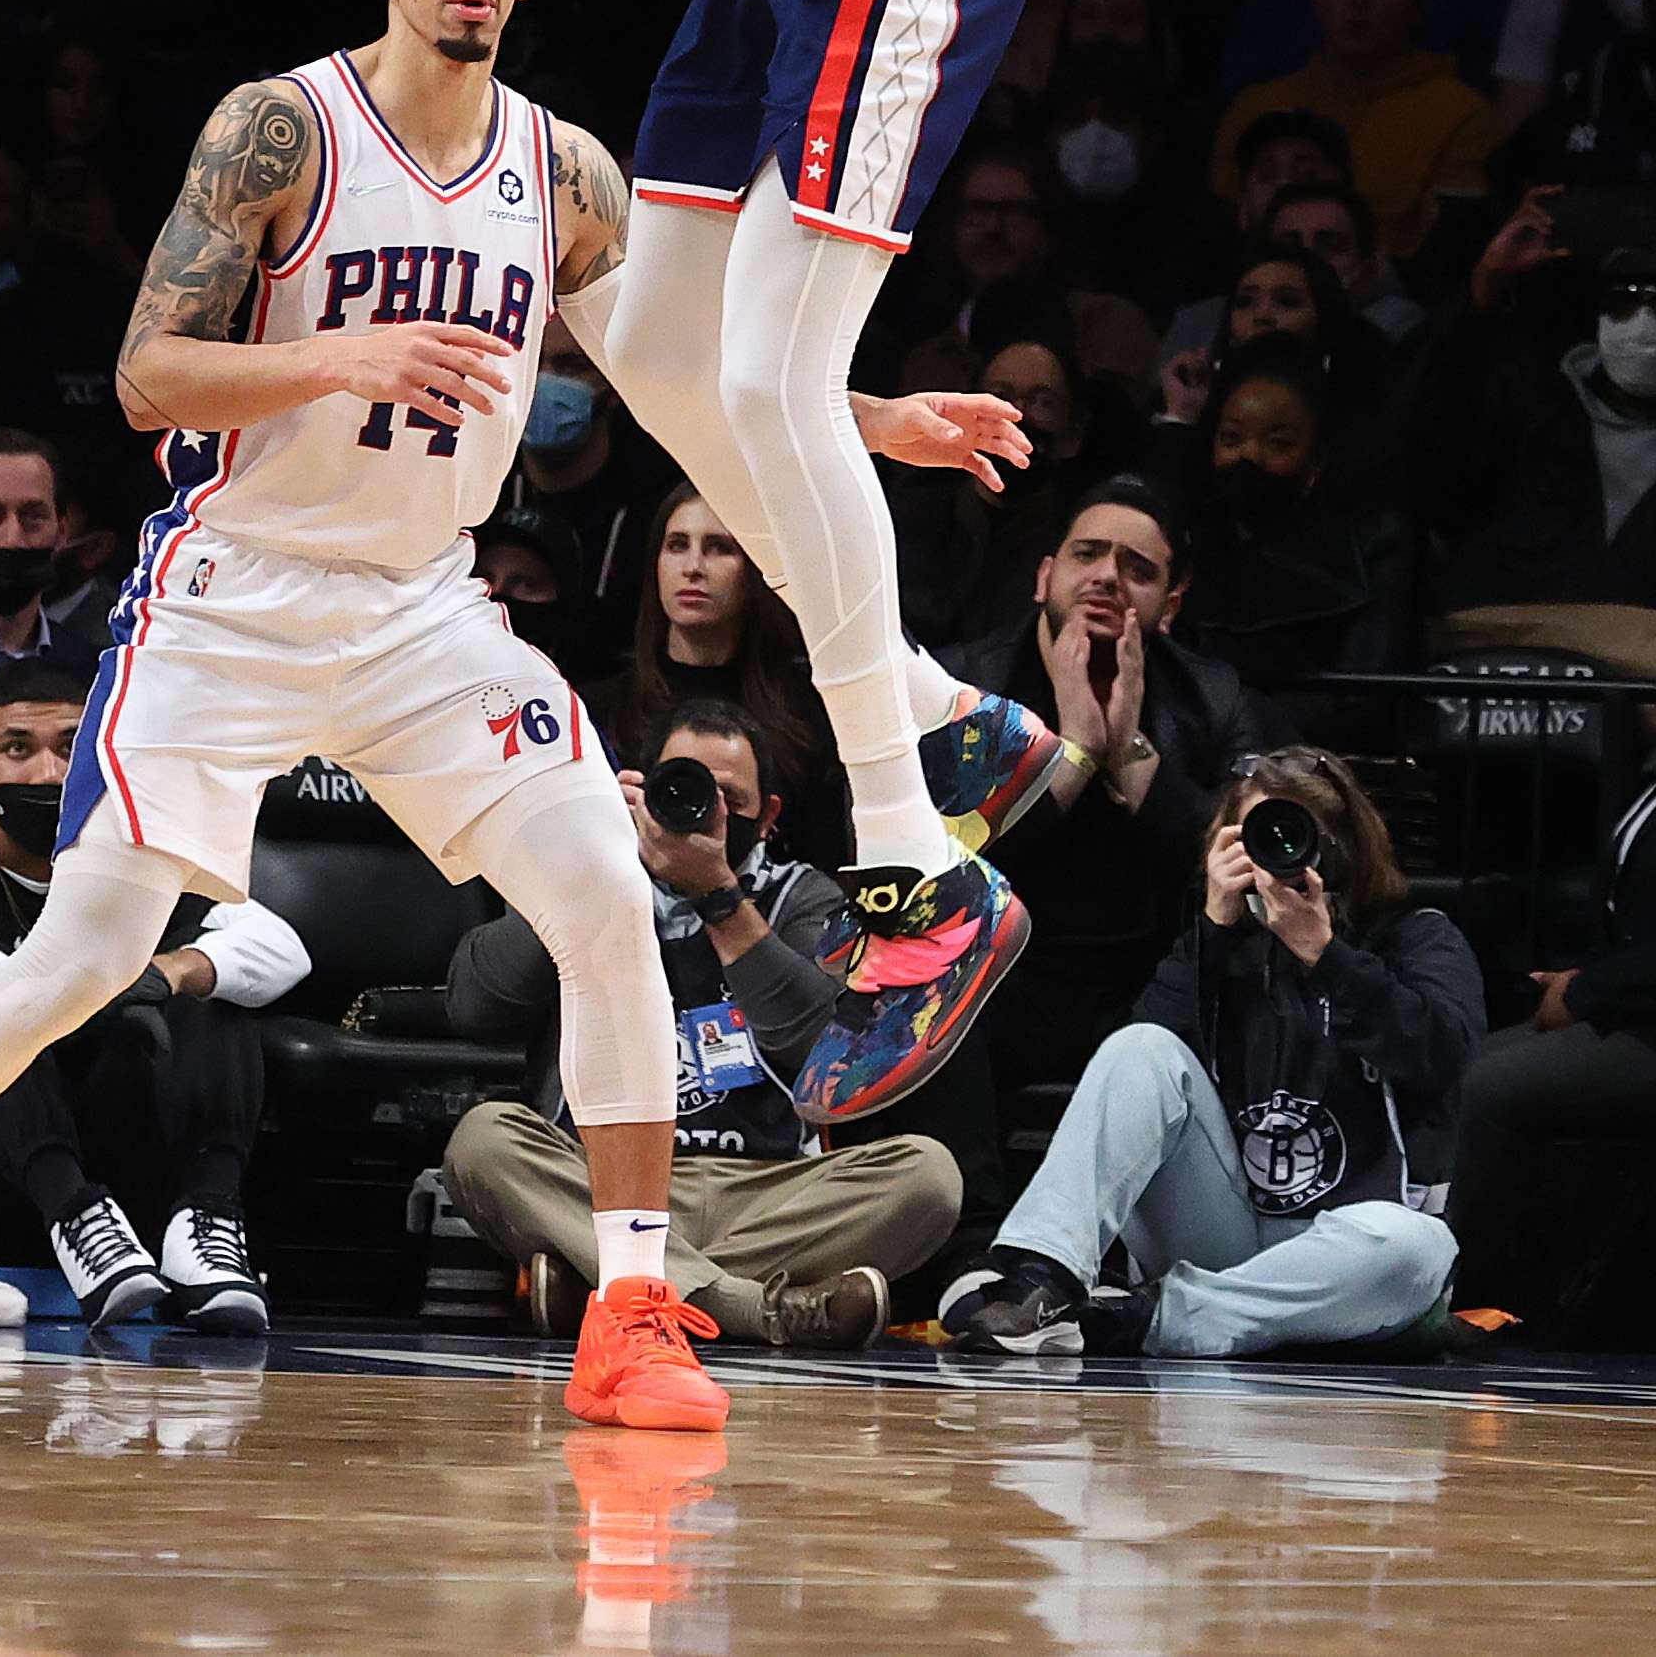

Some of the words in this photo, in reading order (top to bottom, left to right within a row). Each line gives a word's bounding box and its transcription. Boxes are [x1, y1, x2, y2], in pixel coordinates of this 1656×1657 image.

[487, 208, 539, 225] crypto.com
[316, 246, 535, 352] PHILA
[486, 698, 561, 763] 76
